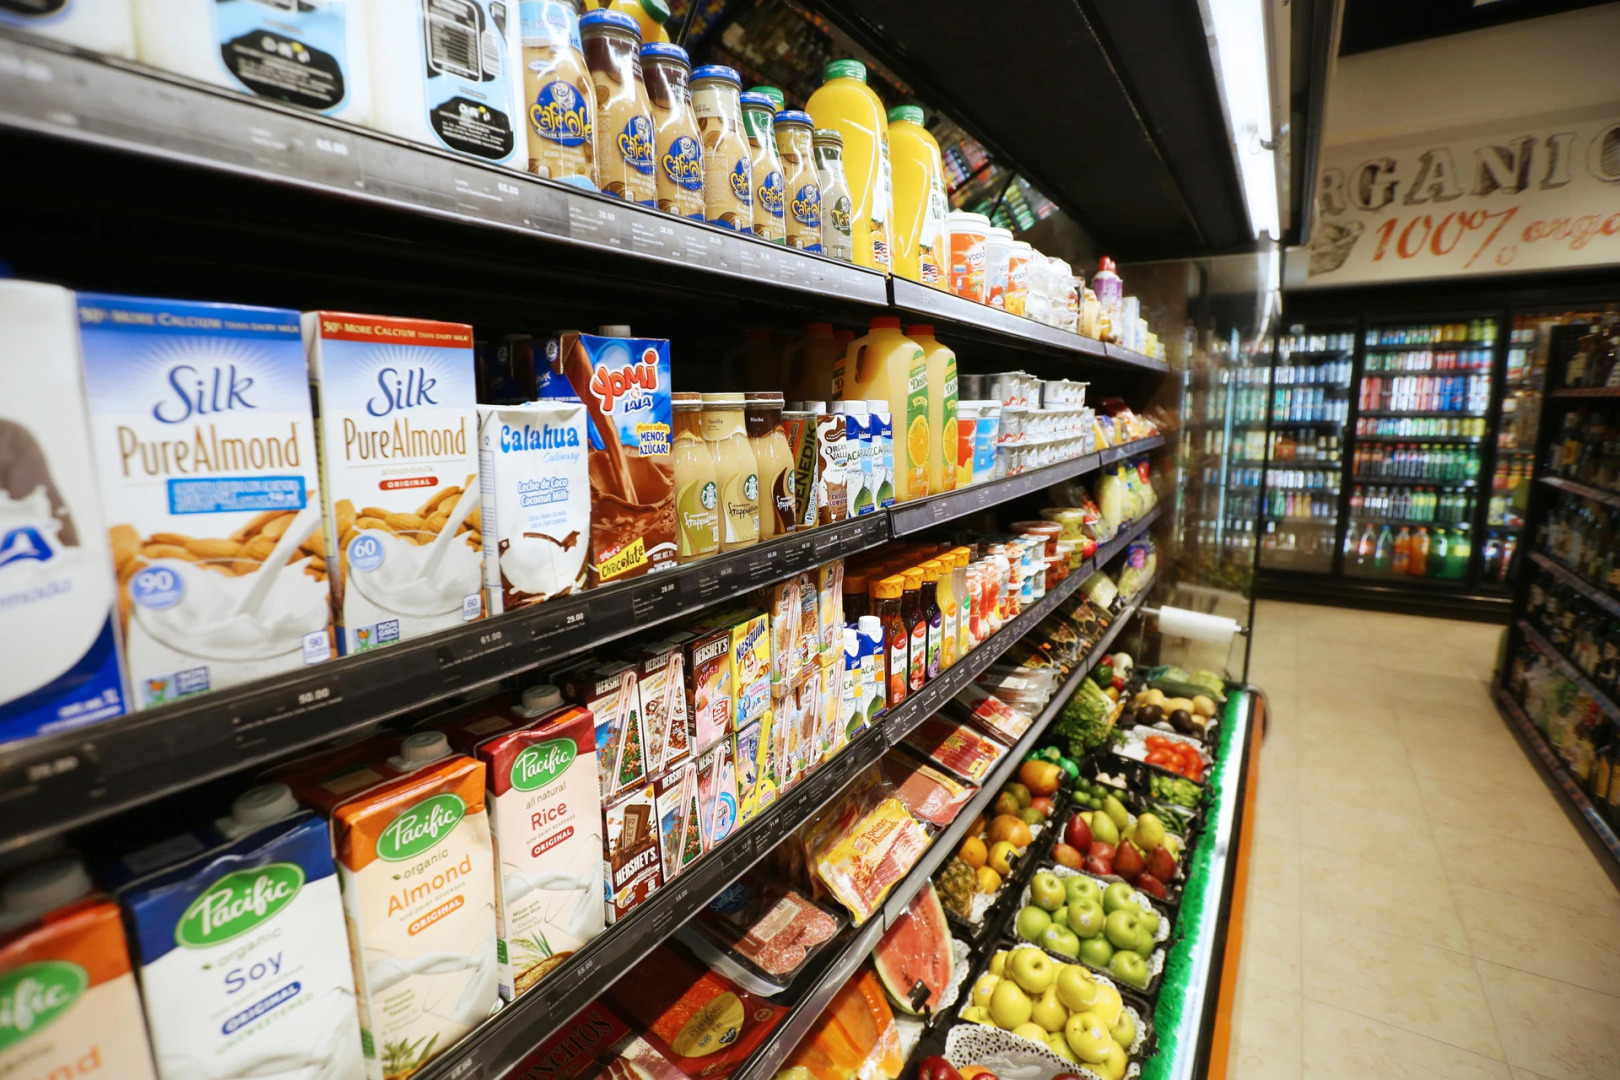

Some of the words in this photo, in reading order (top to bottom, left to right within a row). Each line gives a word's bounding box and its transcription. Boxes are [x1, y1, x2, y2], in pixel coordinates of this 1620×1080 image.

[1319, 122, 1620, 217] RGANIC
[1371, 205, 1521, 269] 100%
[344, 323, 373, 335] MORE
[374, 325, 416, 339] CALCIUM
[152, 364, 258, 424] Silk
[366, 367, 439, 417] Silk
[624, 396, 652, 414] LALA
[501, 424, 580, 454] Calahua
[639, 442, 669, 455] AZÚCAR!
[640, 432, 665, 442] MENOS
[386, 478, 431, 489] ORIGINAL
[518, 479, 540, 494] Leche
[540, 477, 551, 490] de
[551, 476, 568, 489] Coco
[520, 491, 552, 507] Coconut
[551, 488, 569, 501] Milk
[354, 540, 377, 558] 60
[601, 545, 644, 578] Chocolate
[137, 570, 175, 593] 90
[661, 583, 675, 594] 28.00
[378, 621, 398, 631] NON
[566, 612, 584, 624] 29.00
[378, 627, 398, 637] GMO
[480, 631, 502, 645] 61.00
[645, 651, 671, 673] HERSHE
[595, 674, 622, 696] HERSHE
[515, 743, 569, 783] Pacific
[525, 796, 536, 810] all
[536, 781, 567, 805] natural
[384, 803, 458, 852] Pacific
[530, 802, 568, 831] Rice
[533, 828, 573, 855] ORIGINAL
[403, 848, 450, 880] organic
[614, 846, 658, 887] HERSHEY'S
[387, 853, 473, 918] Almond
[189, 874, 295, 936] Pacific
[410, 898, 462, 932] ORIGINAL
[224, 951, 283, 995] Soy
[576, 960, 594, 976] 55.00
